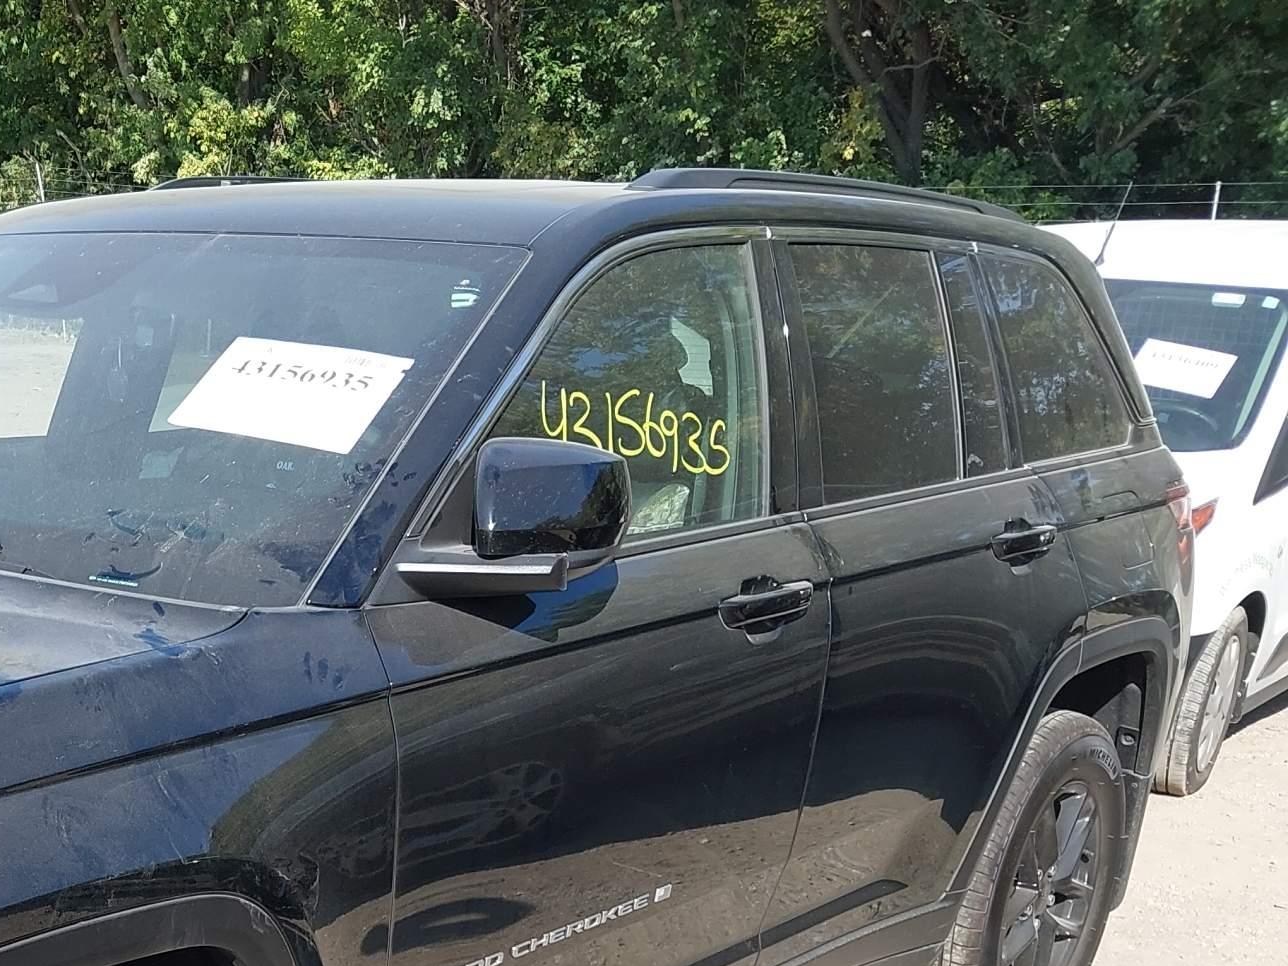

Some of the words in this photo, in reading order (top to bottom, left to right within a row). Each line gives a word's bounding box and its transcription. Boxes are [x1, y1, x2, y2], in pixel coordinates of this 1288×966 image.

[230, 359, 374, 392] 43156935
[541, 379, 731, 476] 43156935
[511, 893, 650, 959] CHEROKEE
